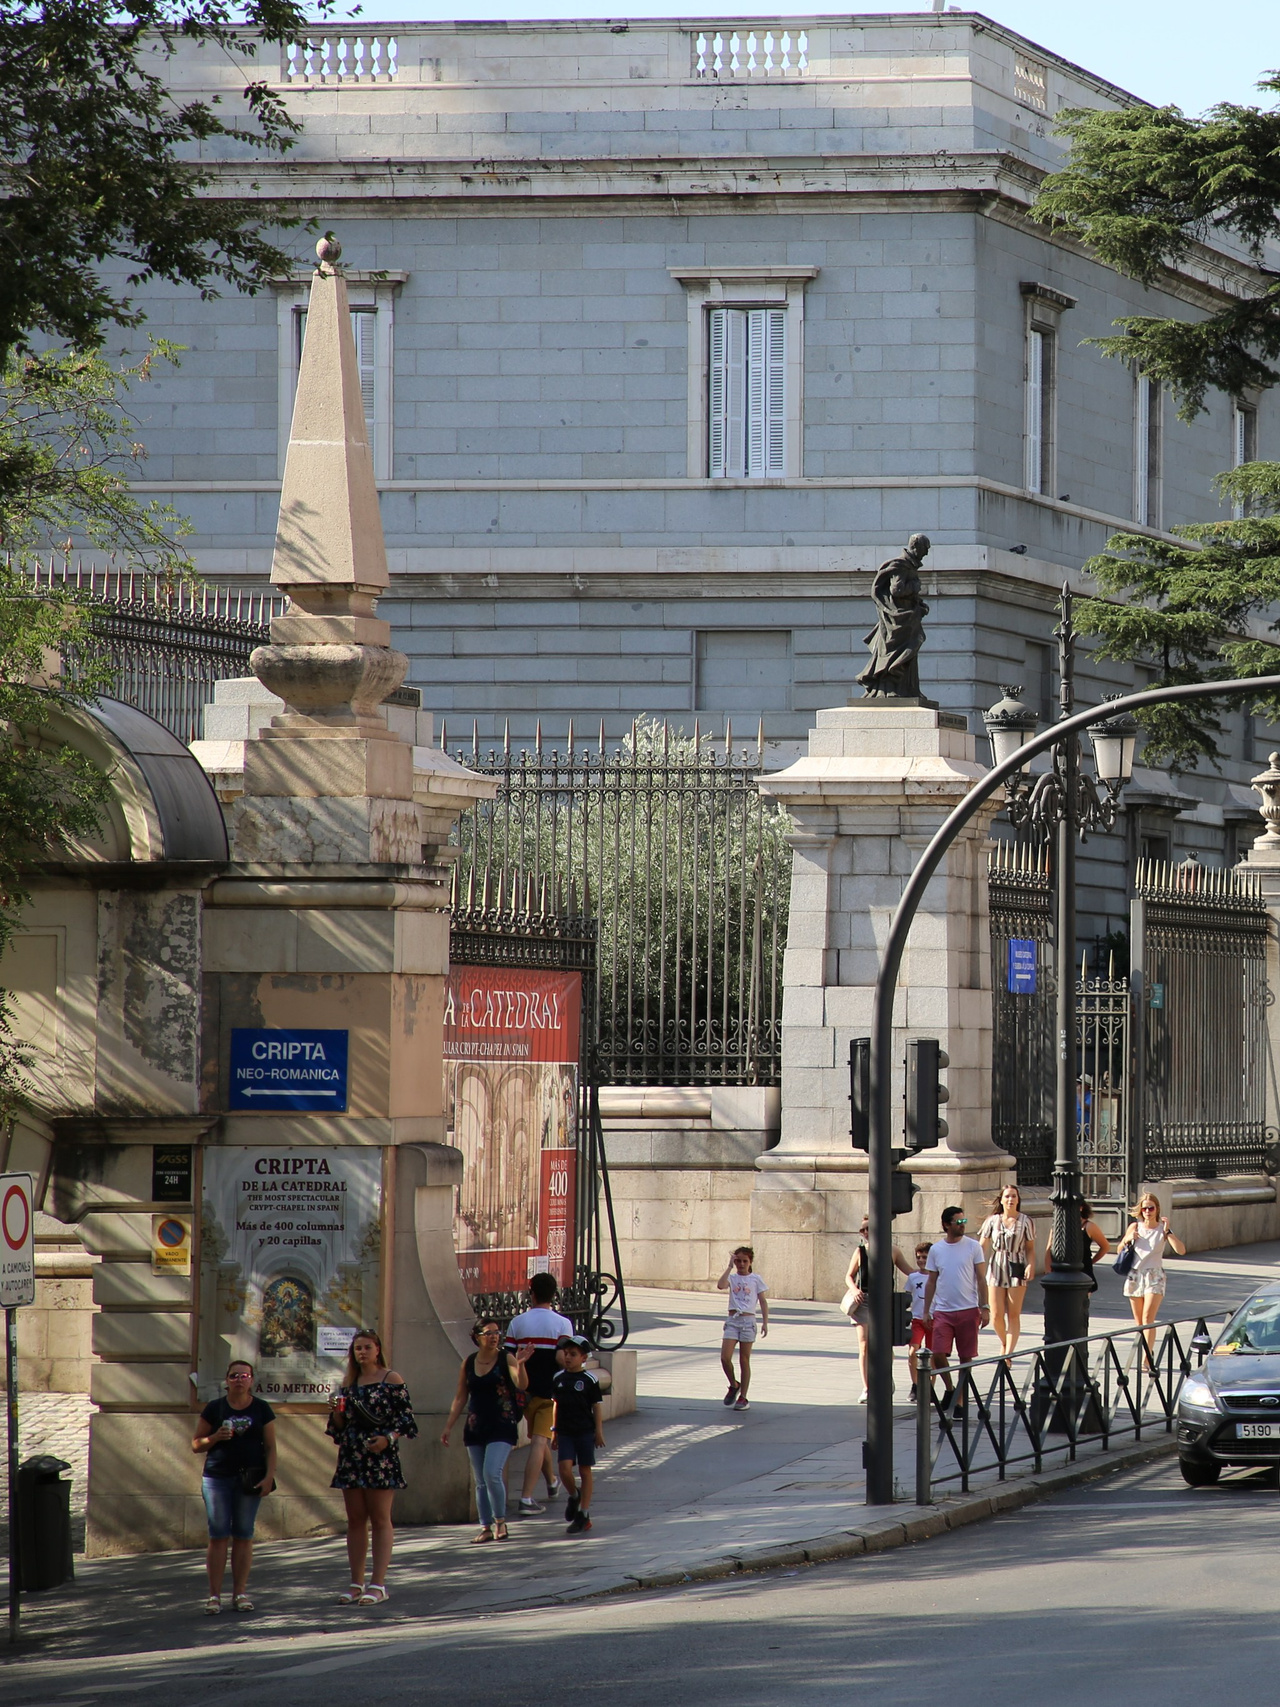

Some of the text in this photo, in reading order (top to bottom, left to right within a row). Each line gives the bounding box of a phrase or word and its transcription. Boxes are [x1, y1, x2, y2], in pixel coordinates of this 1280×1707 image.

[443, 986, 456, 1026] A
[471, 989, 561, 1029] CATEDRAL
[252, 1042, 326, 1060] CRIPTA
[443, 1041, 528, 1056] ULAR CRYPT-CHAPEL IN SPAIN
[237, 1068, 340, 1080] NEO-ROMANICA
[168, 1155, 188, 1164] GSS
[254, 1158, 331, 1174] CRIPTA
[164, 1176, 178, 1184] 24H
[548, 1171, 568, 1197] 400
[242, 1181, 348, 1192] DE LA CATEDRAL
[236, 1222, 344, 1231] Más de 400 columnas
[259, 1236, 322, 1247] y 20 capillas
[7, 1261, 31, 1273] CAMIONES
[255, 1384, 331, 1393] A 50 METROS
[1244, 1425, 1271, 1436] 5190
